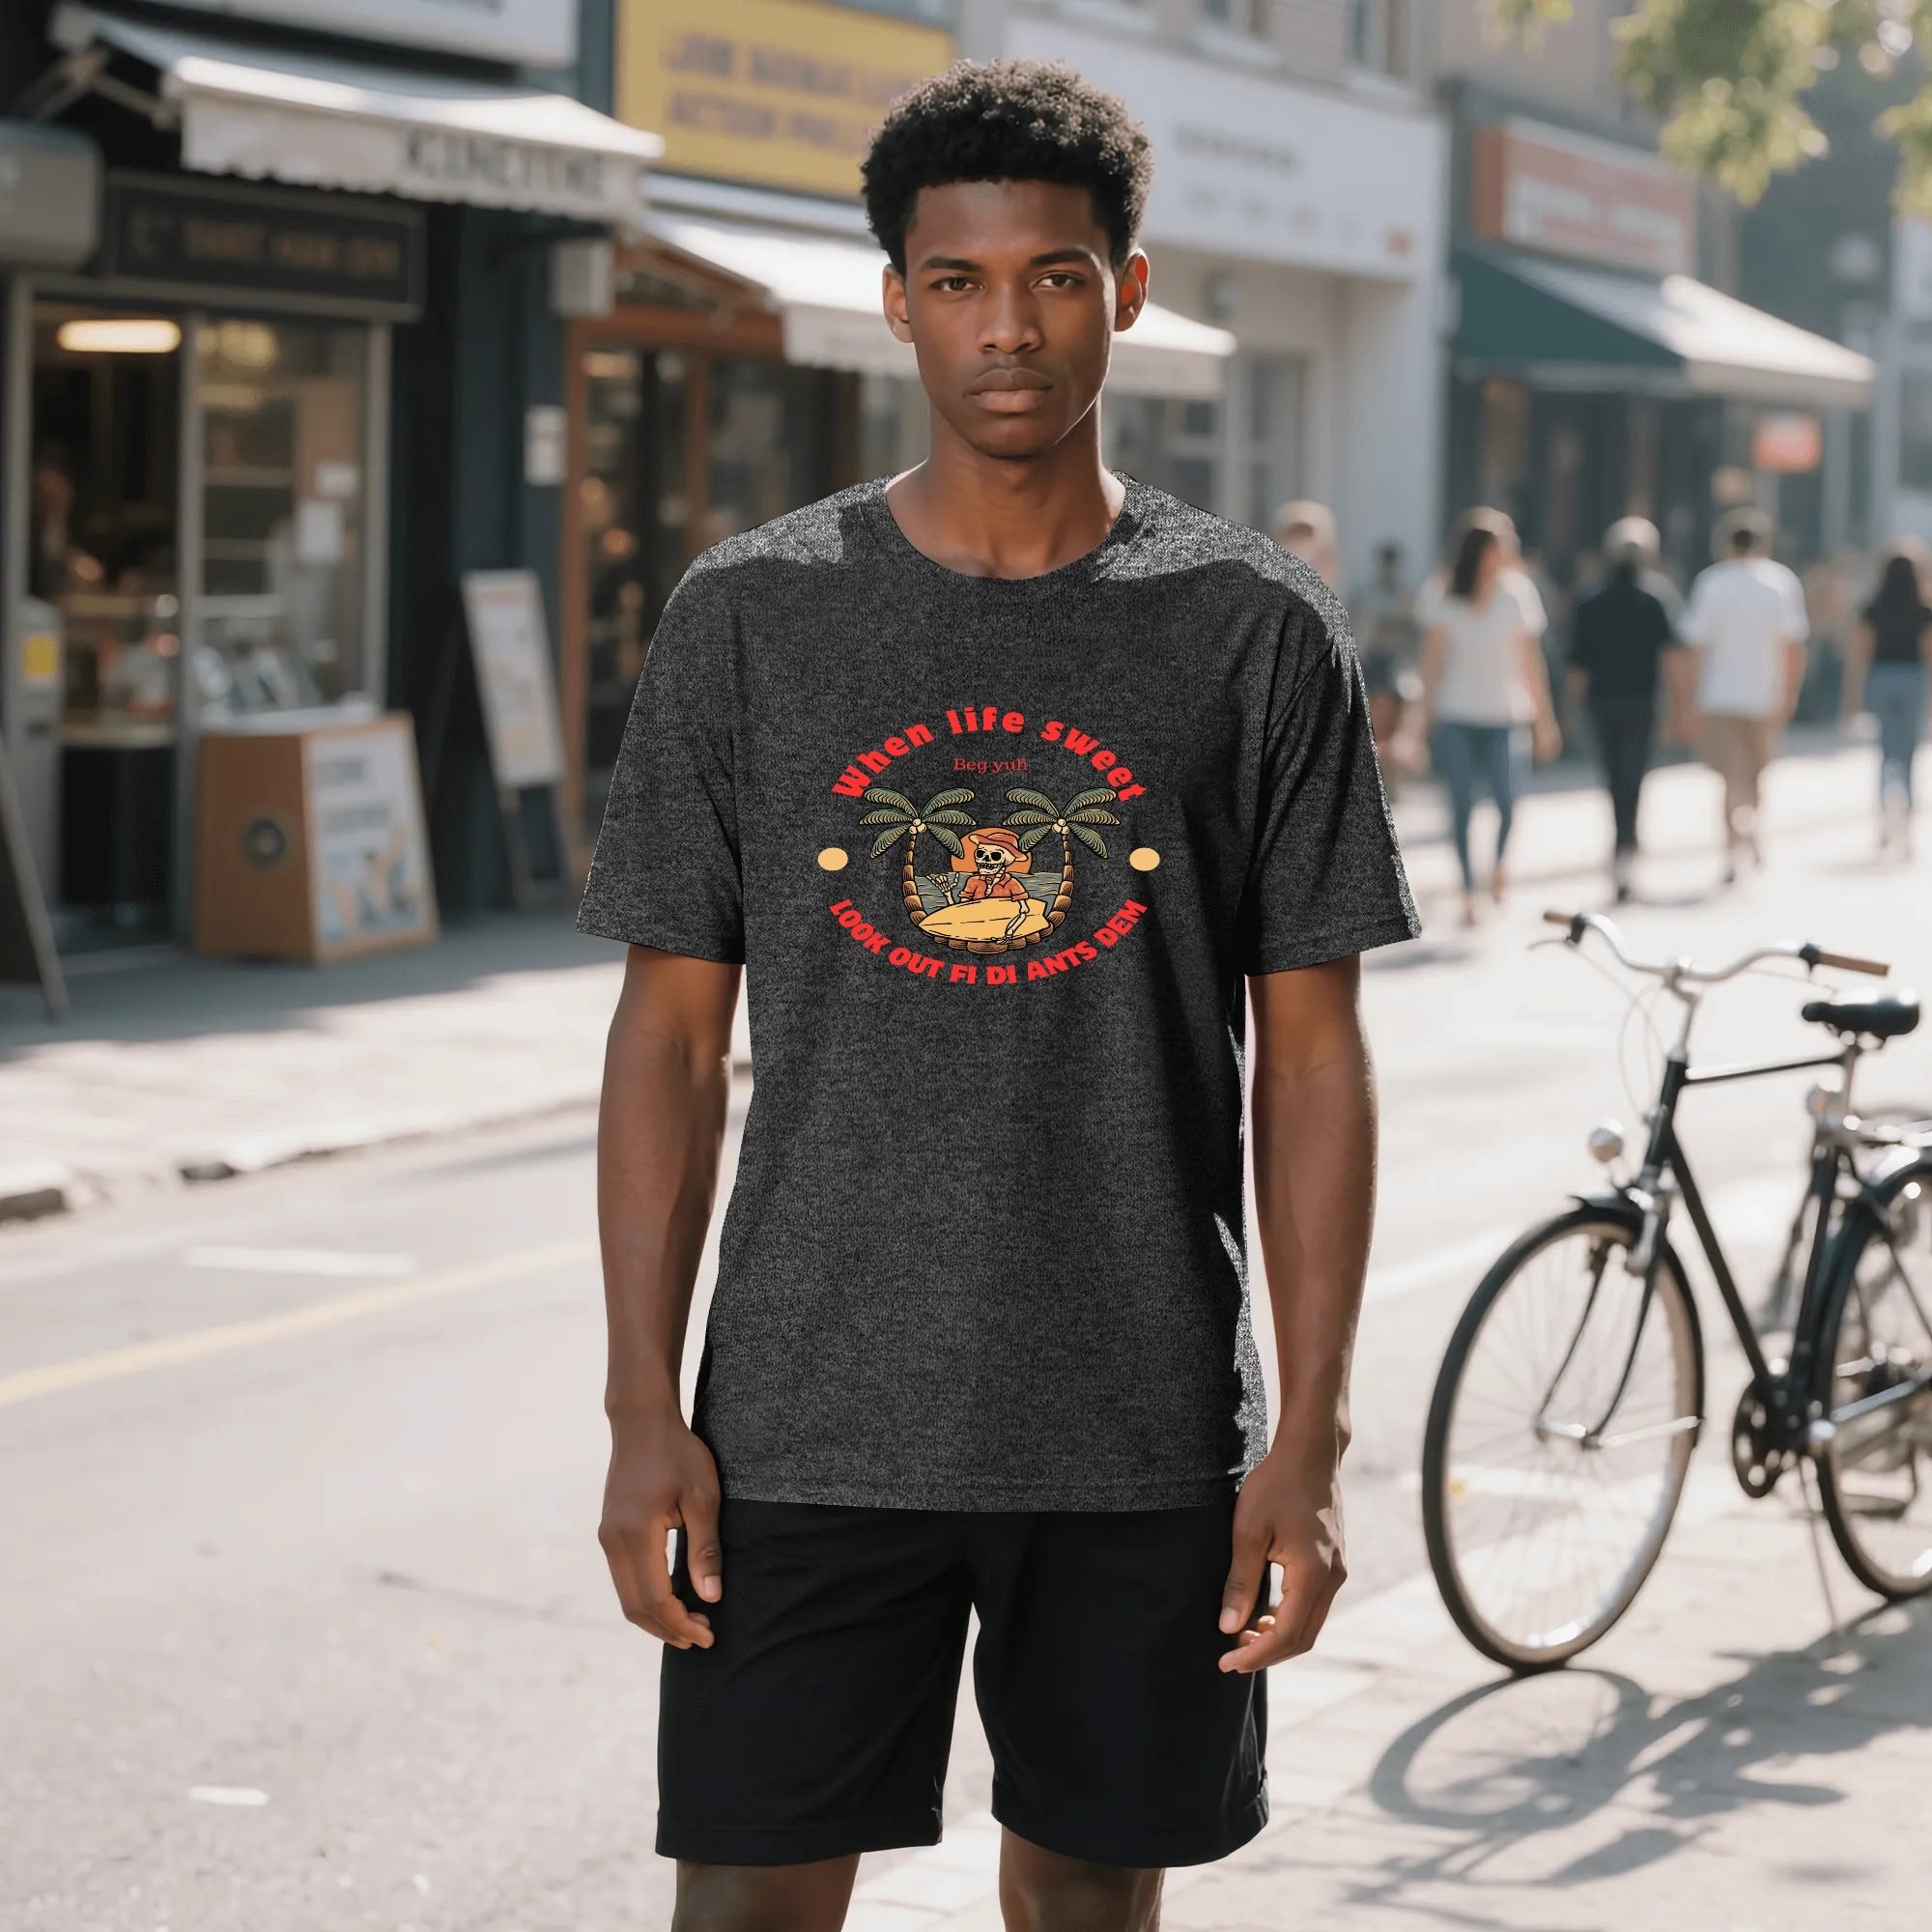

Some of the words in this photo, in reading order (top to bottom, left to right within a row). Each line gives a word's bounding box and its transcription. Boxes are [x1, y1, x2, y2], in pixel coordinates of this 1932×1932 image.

[831, 723, 935, 799] When
[946, 705, 1026, 735] life
[1040, 720, 1148, 802] sweet
[952, 757, 988, 774] Beg
[992, 757, 1028, 774] yuh
[829, 898, 892, 955] LOOK
[889, 947, 945, 980] OUT
[949, 963, 977, 984] FI
[986, 964, 1018, 986] DI
[1027, 940, 1098, 981] ANTS
[1094, 898, 1149, 950] DEM
